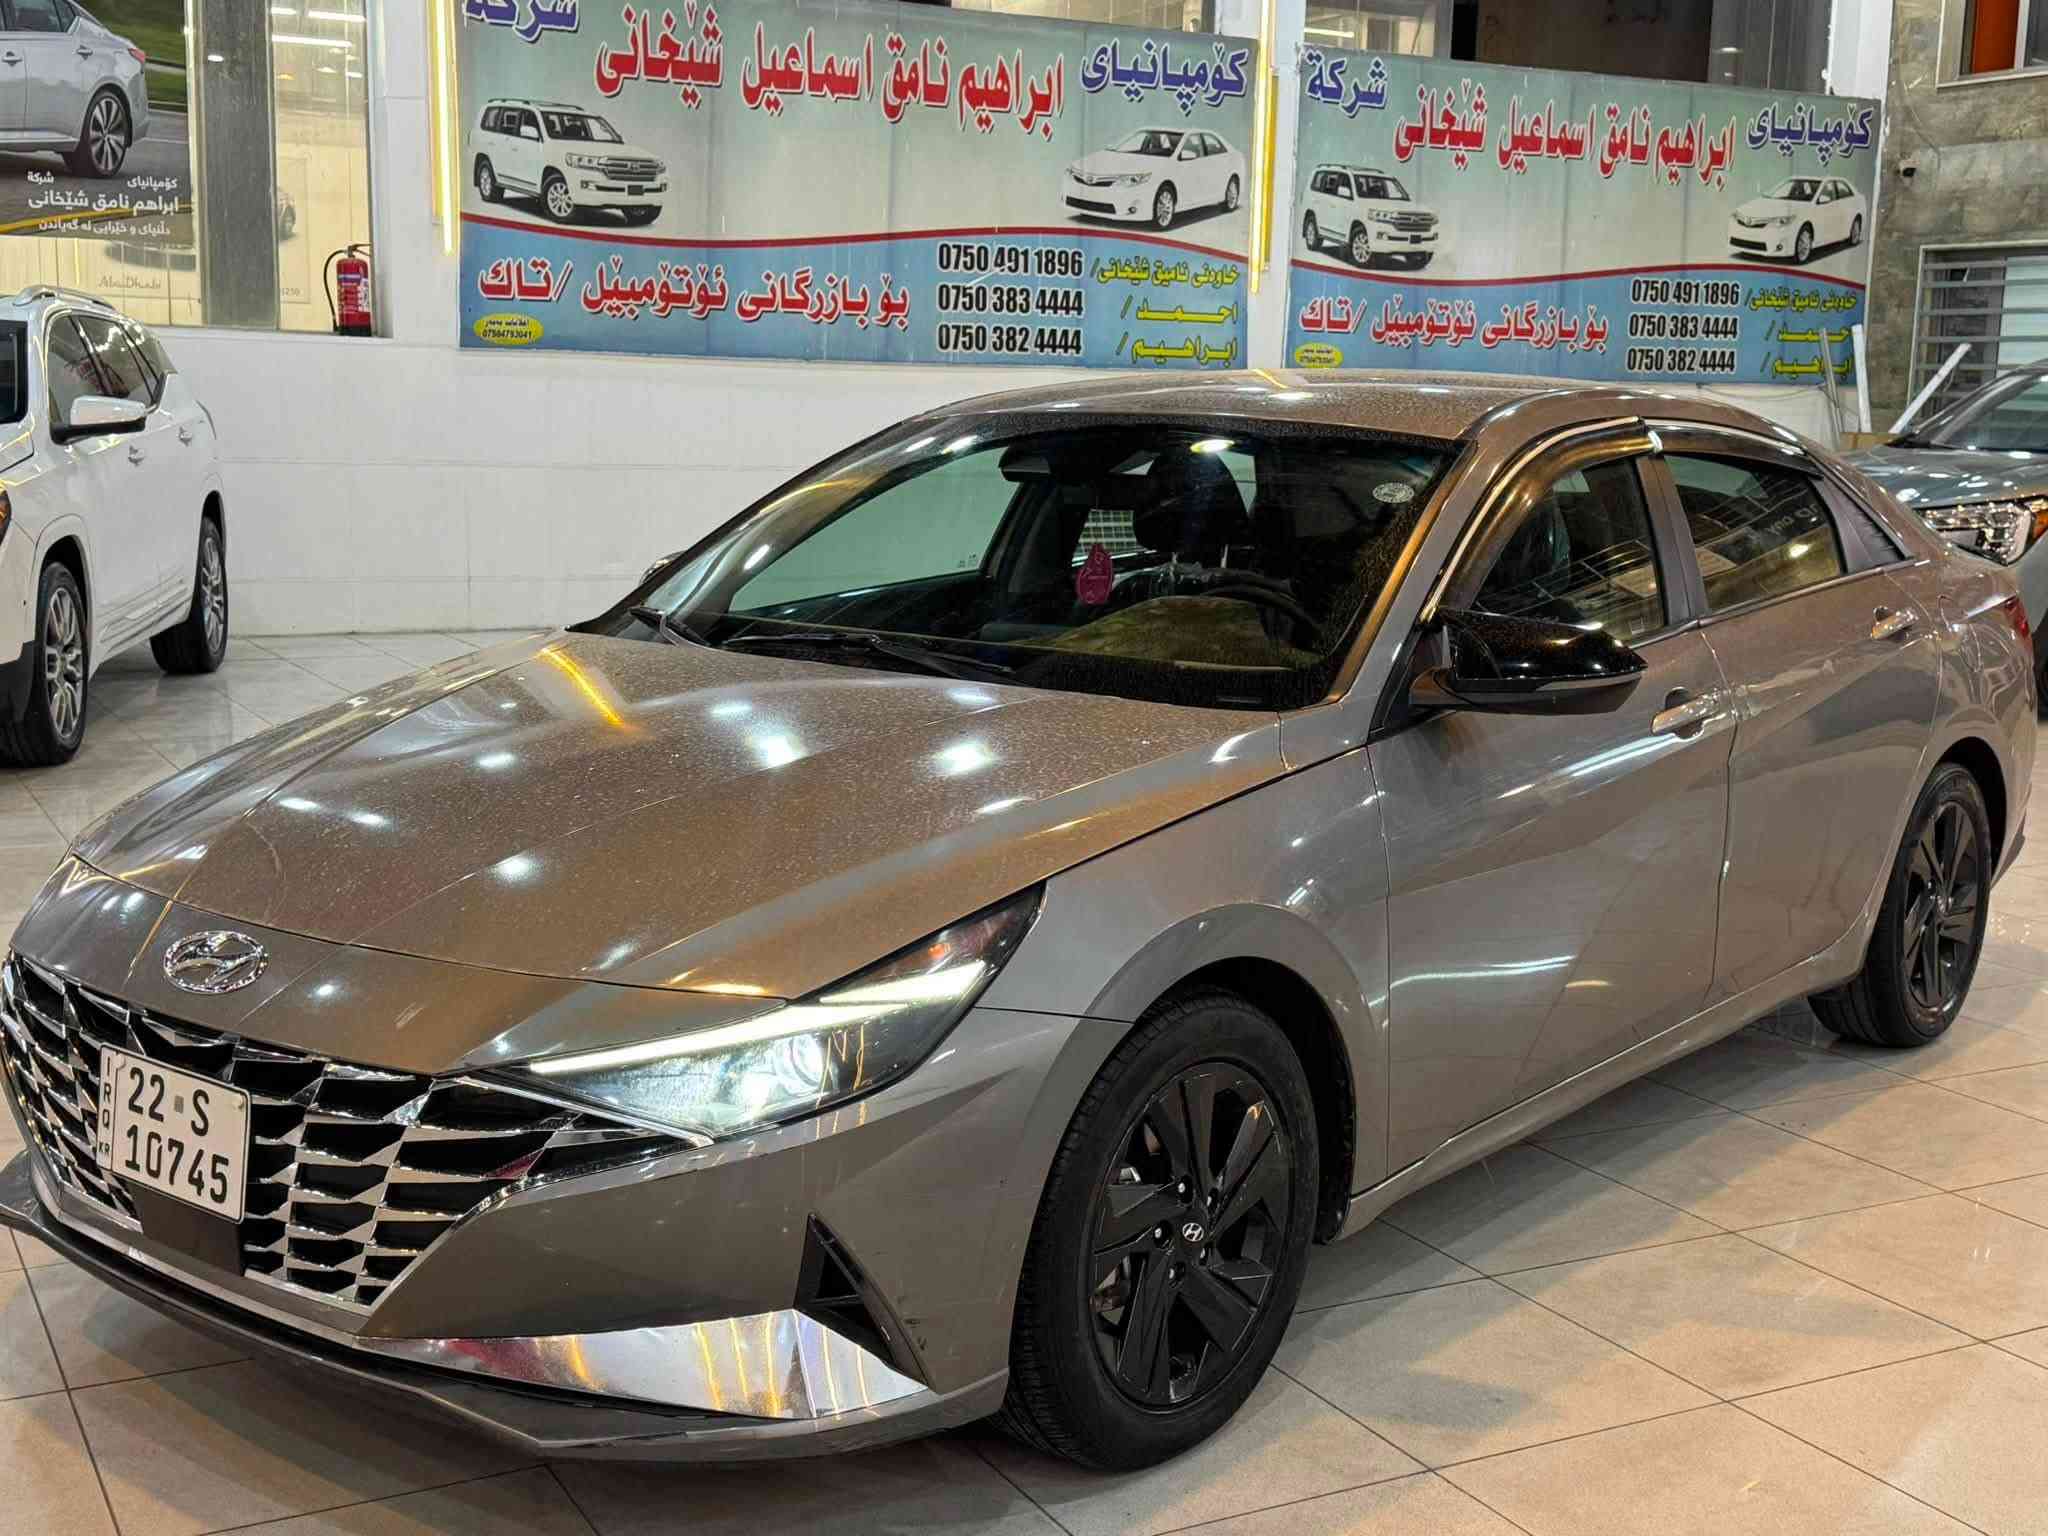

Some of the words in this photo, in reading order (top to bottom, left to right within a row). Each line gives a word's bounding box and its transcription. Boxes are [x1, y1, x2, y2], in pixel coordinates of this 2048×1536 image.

[881, 33, 952, 123] نامق
[1600, 103, 1650, 178] نامق
[937, 242, 989, 273] 0750
[992, 246, 1030, 274] 491
[1033, 249, 1084, 277] 1896
[937, 283, 988, 312] 0750
[991, 286, 1031, 314] 383
[1034, 288, 1084, 316] 4444
[1631, 278, 1670, 304] 0750
[1672, 280, 1700, 305] 491
[1702, 281, 1740, 306] 1896
[937, 323, 988, 352] 0750
[991, 325, 1031, 353] 382
[1033, 327, 1082, 355] 4444
[1628, 313, 1667, 338] 0750
[1669, 314, 1699, 338] 383
[1701, 316, 1739, 339] 4444
[1626, 347, 1665, 372] 0750
[1667, 348, 1697, 372] 382
[1698, 349, 1736, 373] 4444
[128, 1066, 165, 1123] 22
[191, 1088, 210, 1137] S
[124, 1123, 230, 1204] 10745
